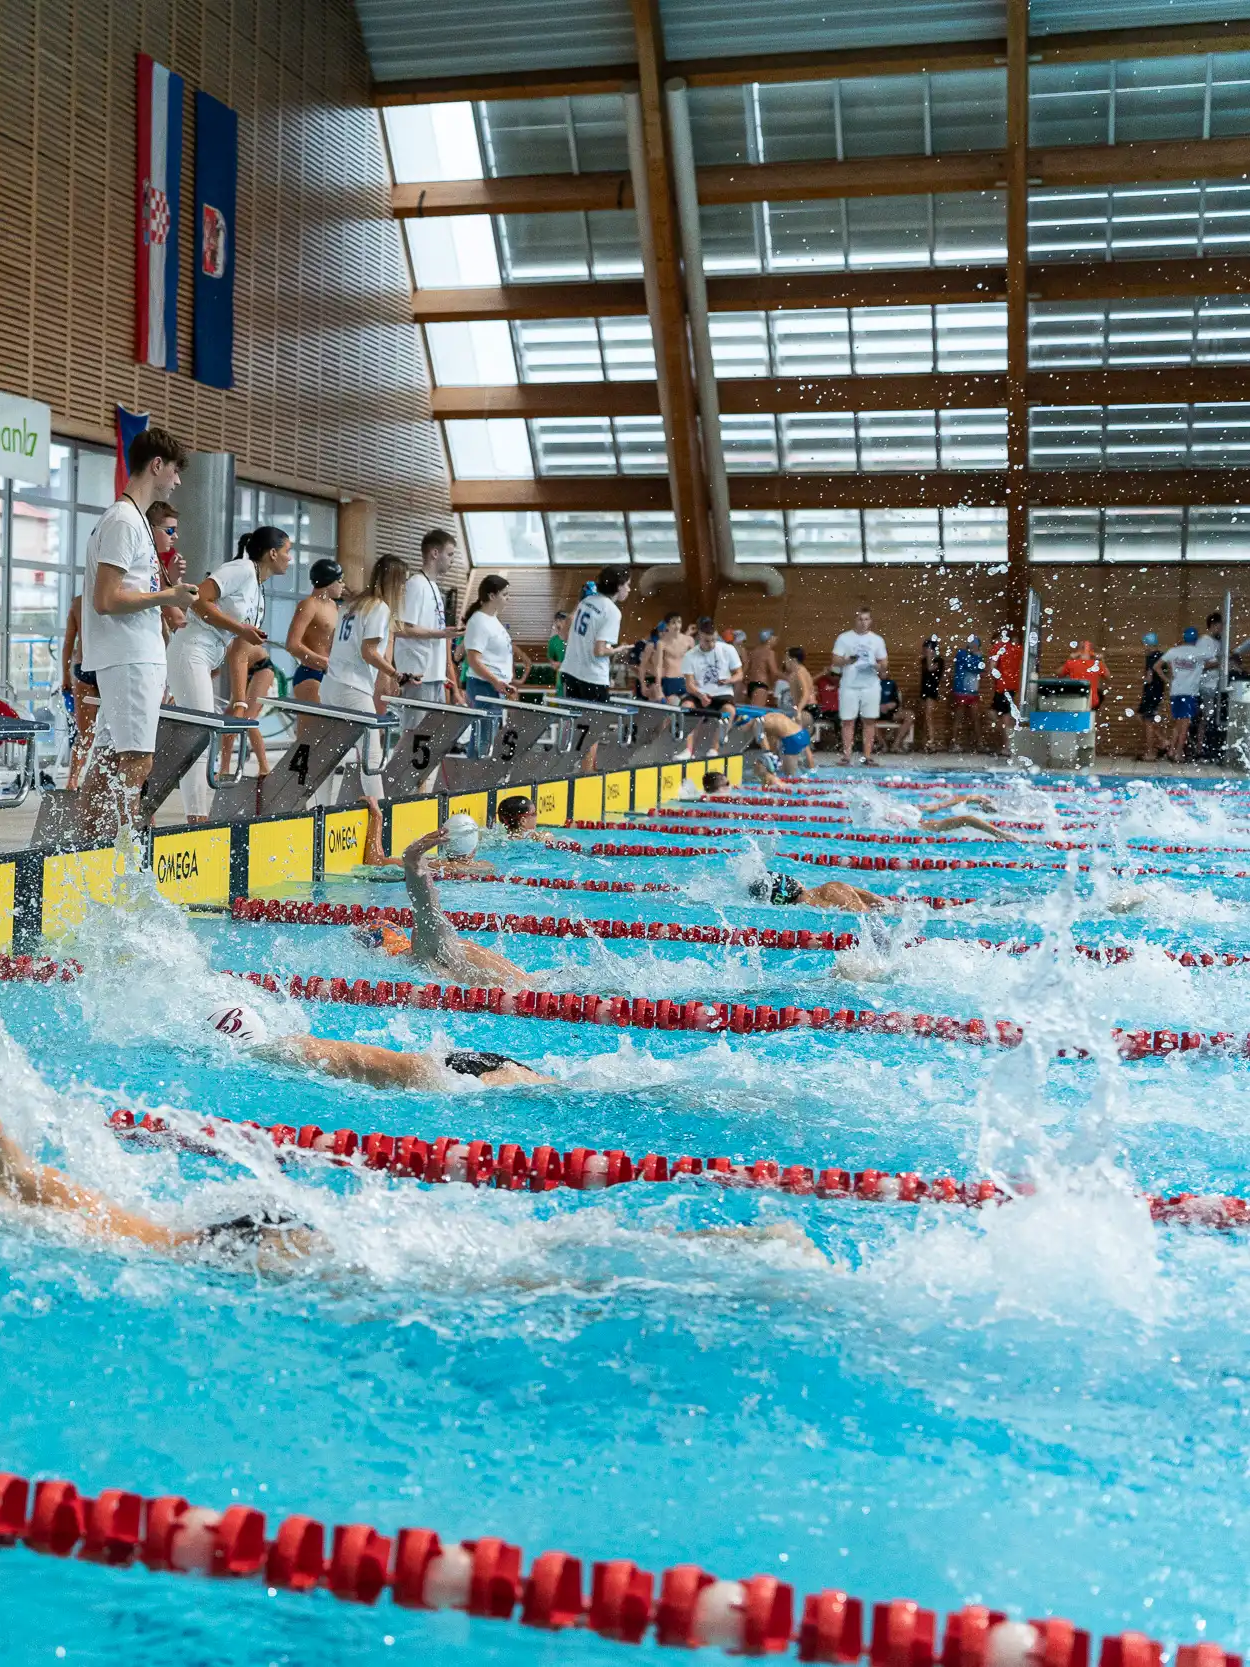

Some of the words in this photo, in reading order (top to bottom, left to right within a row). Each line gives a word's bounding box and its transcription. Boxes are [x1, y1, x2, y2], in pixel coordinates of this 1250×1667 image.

[574, 608, 591, 637] 15
[411, 734, 431, 770] 5
[576, 724, 590, 751] 7
[289, 744, 310, 785] 4
[328, 826, 358, 854] OMEGA
[157, 850, 198, 883] OMEGA
